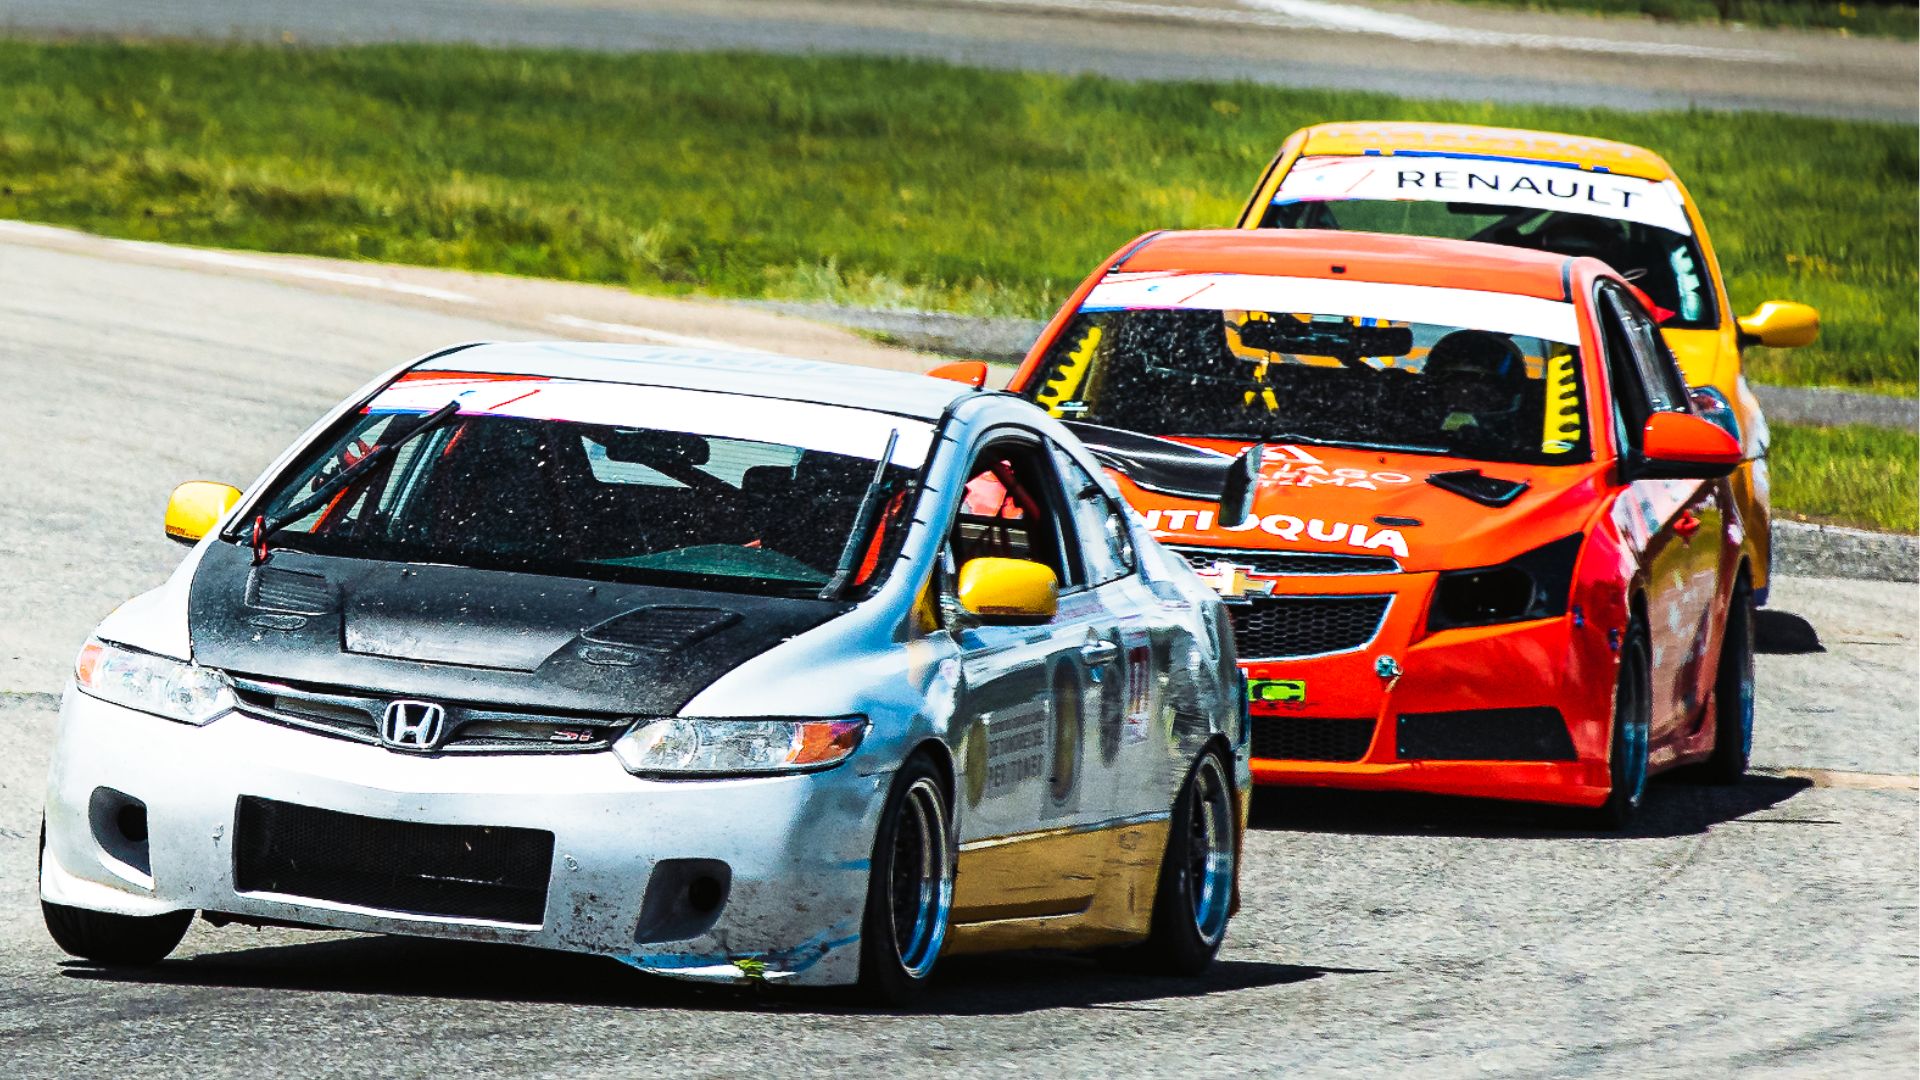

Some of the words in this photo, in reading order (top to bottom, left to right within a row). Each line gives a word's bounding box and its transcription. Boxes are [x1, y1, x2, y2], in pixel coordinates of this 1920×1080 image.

[1397, 170, 1643, 208] RENAULT
[1260, 462, 1412, 484] TIAGO
[1132, 509, 1409, 558] NTIOQUIA
